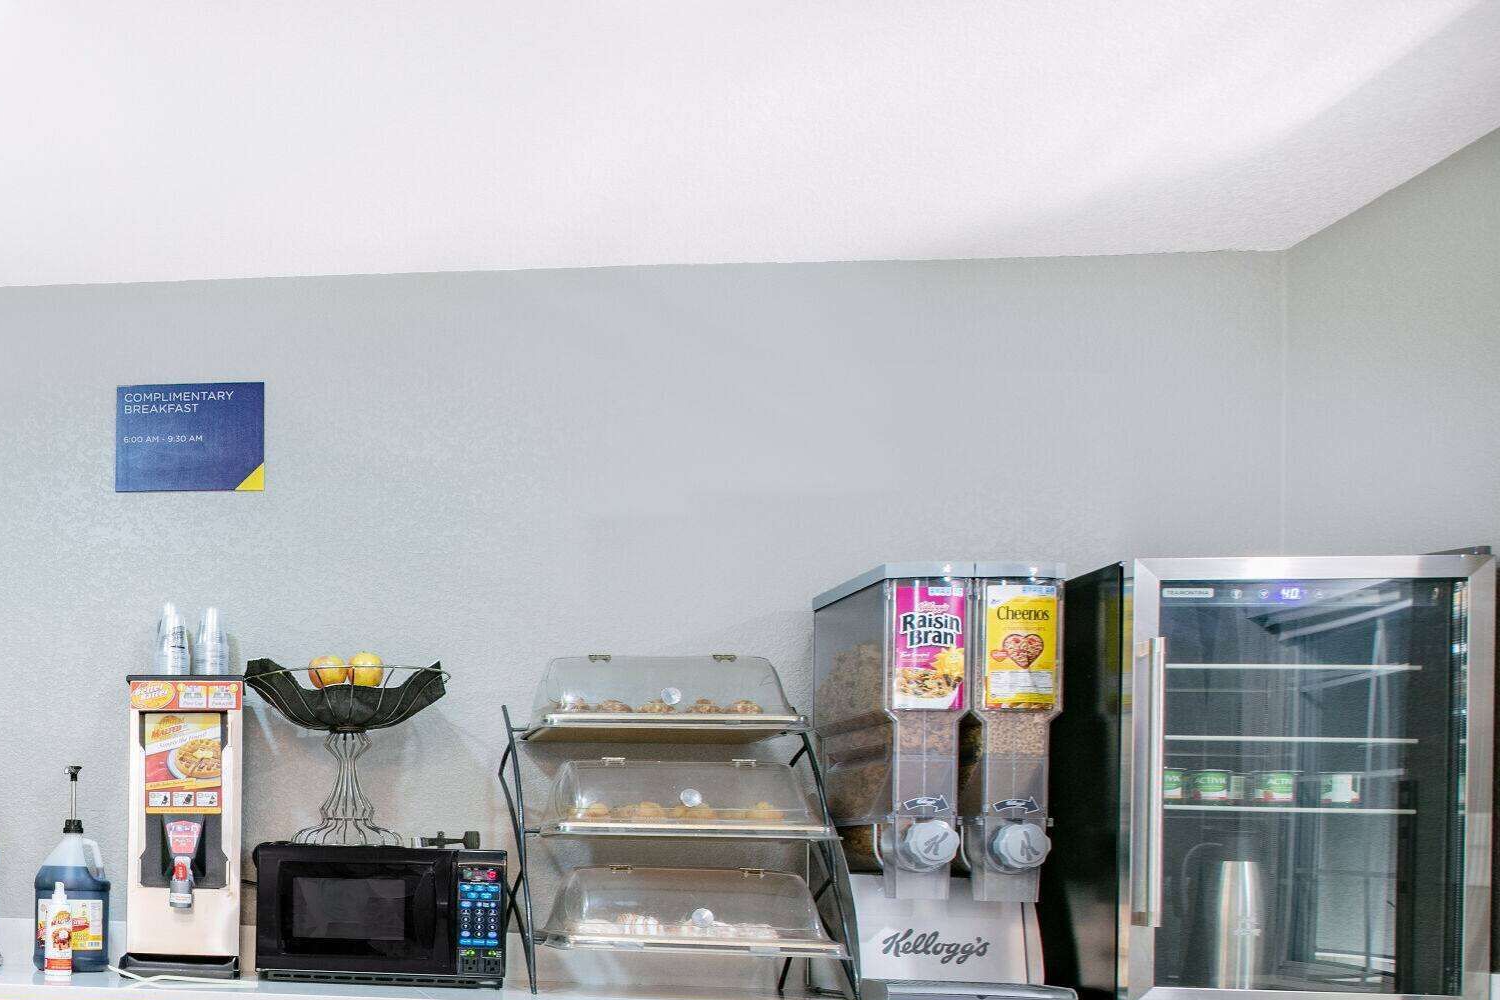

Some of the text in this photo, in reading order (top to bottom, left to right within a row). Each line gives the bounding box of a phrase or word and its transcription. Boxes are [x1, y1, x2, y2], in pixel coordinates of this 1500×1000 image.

[124, 391, 235, 403] COMPLIMENTARY
[124, 403, 199, 414] BREAKFAST
[123, 435, 143, 444] 6:00
[145, 435, 160, 443] AM
[167, 435, 187, 443] 9:30
[188, 434, 204, 442] AM
[1280, 588, 1300, 600] 40
[996, 605, 1051, 621] Cheerios
[902, 613, 961, 633] Raisin
[908, 629, 955, 647] Bran
[882, 928, 990, 965] Kellogg's
